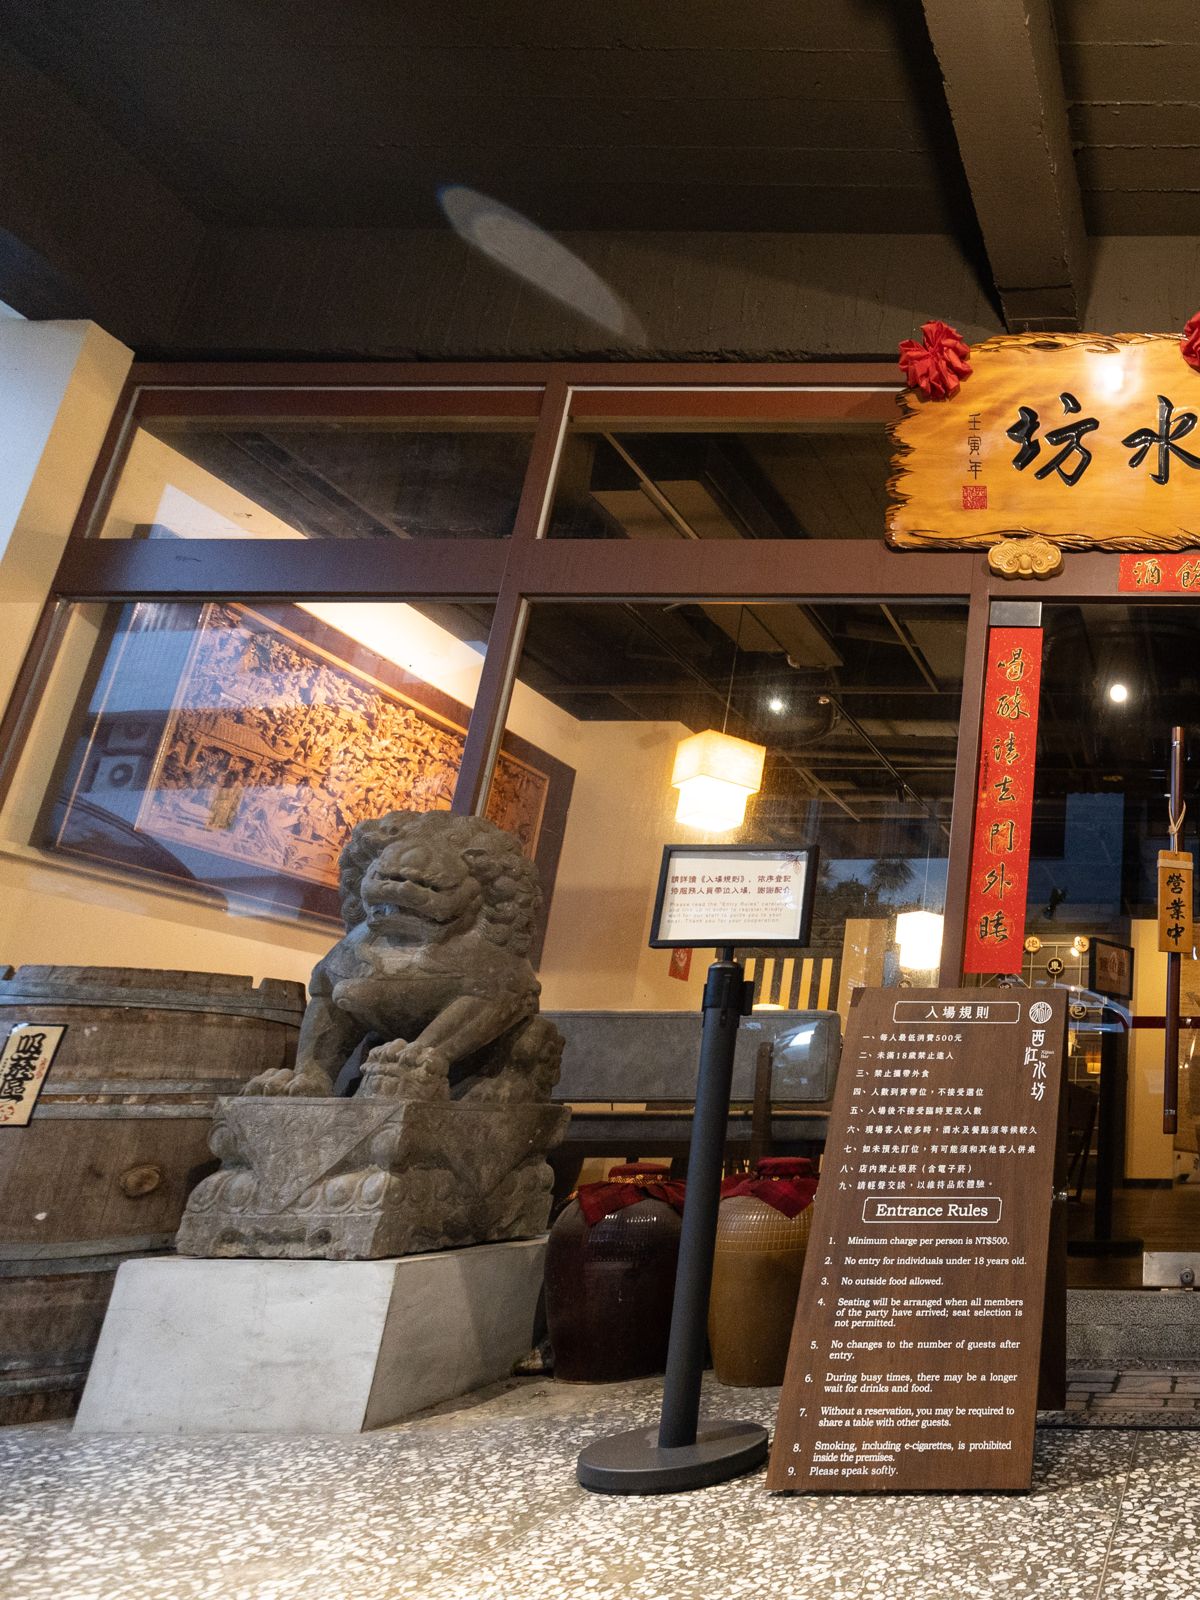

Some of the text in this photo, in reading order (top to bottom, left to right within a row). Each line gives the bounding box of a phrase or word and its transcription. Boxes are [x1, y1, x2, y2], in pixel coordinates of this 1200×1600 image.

[967, 412, 983, 480] 壬寅年
[1165, 873, 1186, 946] 營業中
[924, 1005, 990, 1020] 入場規則
[1024, 1029, 1047, 1101] 西江水坊
[876, 1204, 988, 1217] Entrance Rules
[829, 1236, 1010, 1247] 1. Minimum charge per person is NT$500.
[824, 1256, 1027, 1267] 2. No entry for individuals under 18 years old.
[821, 1277, 944, 1286] 3. No outside food allowed.
[817, 1297, 1024, 1310] 4. Seating will be arranged when all members
[836, 1308, 846, 1317] of
[848, 1308, 862, 1317] the
[865, 1309, 889, 1318] party
[892, 1308, 912, 1316] have
[916, 1308, 949, 1318] arrived;
[974, 1308, 1011, 1316] selection
[1015, 1308, 1023, 1316] is
[834, 1318, 896, 1329] not permitted.
[810, 1340, 1020, 1351] 5. No changes to the number of guests after
[829, 1352, 855, 1362] entry.
[805, 1374, 813, 1383] 6.
[826, 1373, 858, 1384] During
[861, 1373, 883, 1384] busy
[886, 1372, 913, 1383] times,
[917, 1372, 940, 1382] there
[944, 1375, 963, 1384] may
[966, 1372, 977, 1381] be
[990, 1373, 1018, 1384] longer
[824, 1383, 932, 1393] wait for drinks and food.
[800, 1408, 808, 1417] 7.
[821, 1406, 855, 1416] Without
[864, 1406, 914, 1416] reservation,
[916, 1408, 932, 1418] you
[935, 1408, 954, 1418] may
[956, 1406, 966, 1415] be
[968, 1406, 1004, 1418] required
[1006, 1407, 1015, 1415] to
[818, 1418, 843, 1427] share
[853, 1418, 874, 1427] table
[876, 1418, 894, 1427] with
[896, 1417, 920, 1427] other
[921, 1419, 951, 1429] guests.
[793, 1441, 1012, 1452] 8. Smoking, including e-cigarettes, is prohibited
[813, 1452, 895, 1464] inside the premises.
[788, 1465, 898, 1478] 9. Please speak softly.
